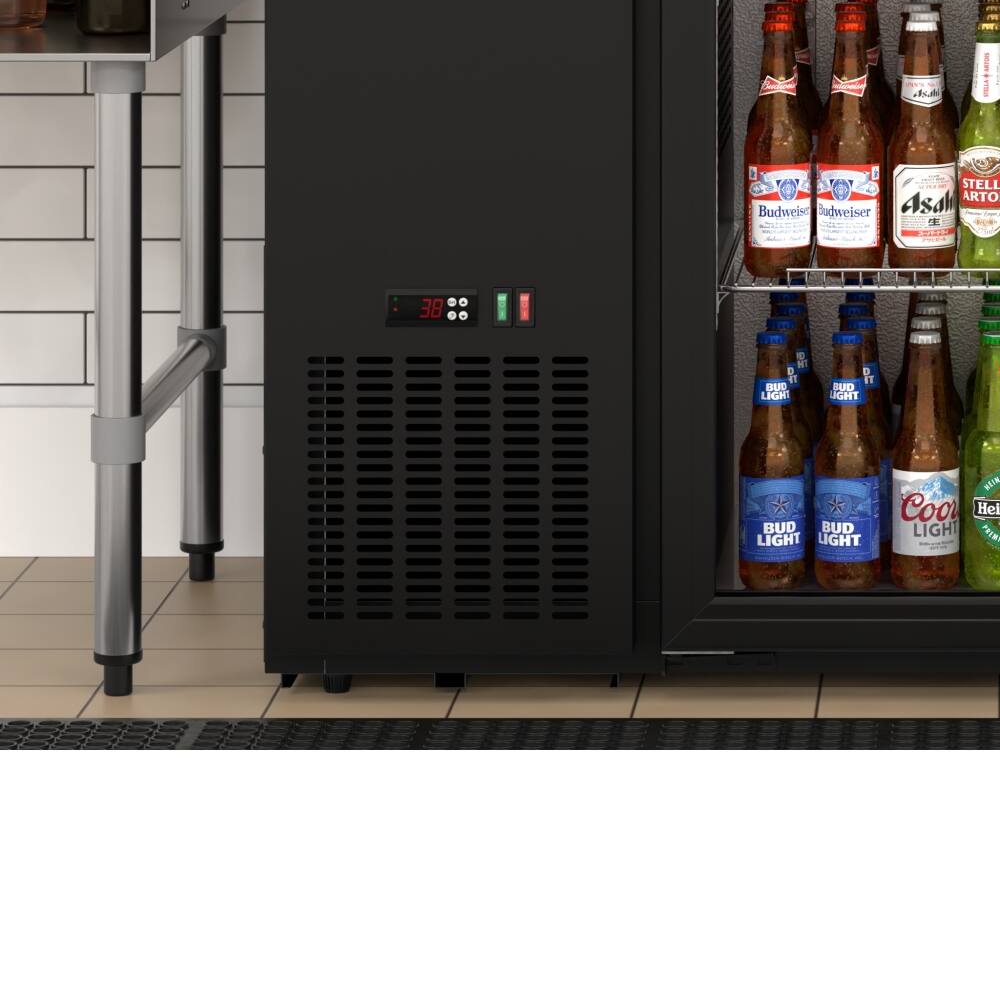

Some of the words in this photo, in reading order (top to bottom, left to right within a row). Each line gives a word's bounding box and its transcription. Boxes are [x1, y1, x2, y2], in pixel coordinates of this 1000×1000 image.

[912, 88, 940, 99] Asahi
[901, 189, 954, 215] Asah
[758, 204, 810, 218] Budweiser
[818, 203, 871, 218] Budweiser
[419, 298, 445, 318] 38
[765, 382, 787, 391] BUD
[832, 382, 855, 392] BUD
[761, 390, 790, 400] LIGHT
[830, 390, 860, 401] LIGHT
[763, 520, 797, 534] BUD
[821, 520, 855, 534] BUD
[913, 520, 958, 538] LIGHT
[757, 531, 801, 547] LIGHT
[818, 531, 862, 547] LIGHT
